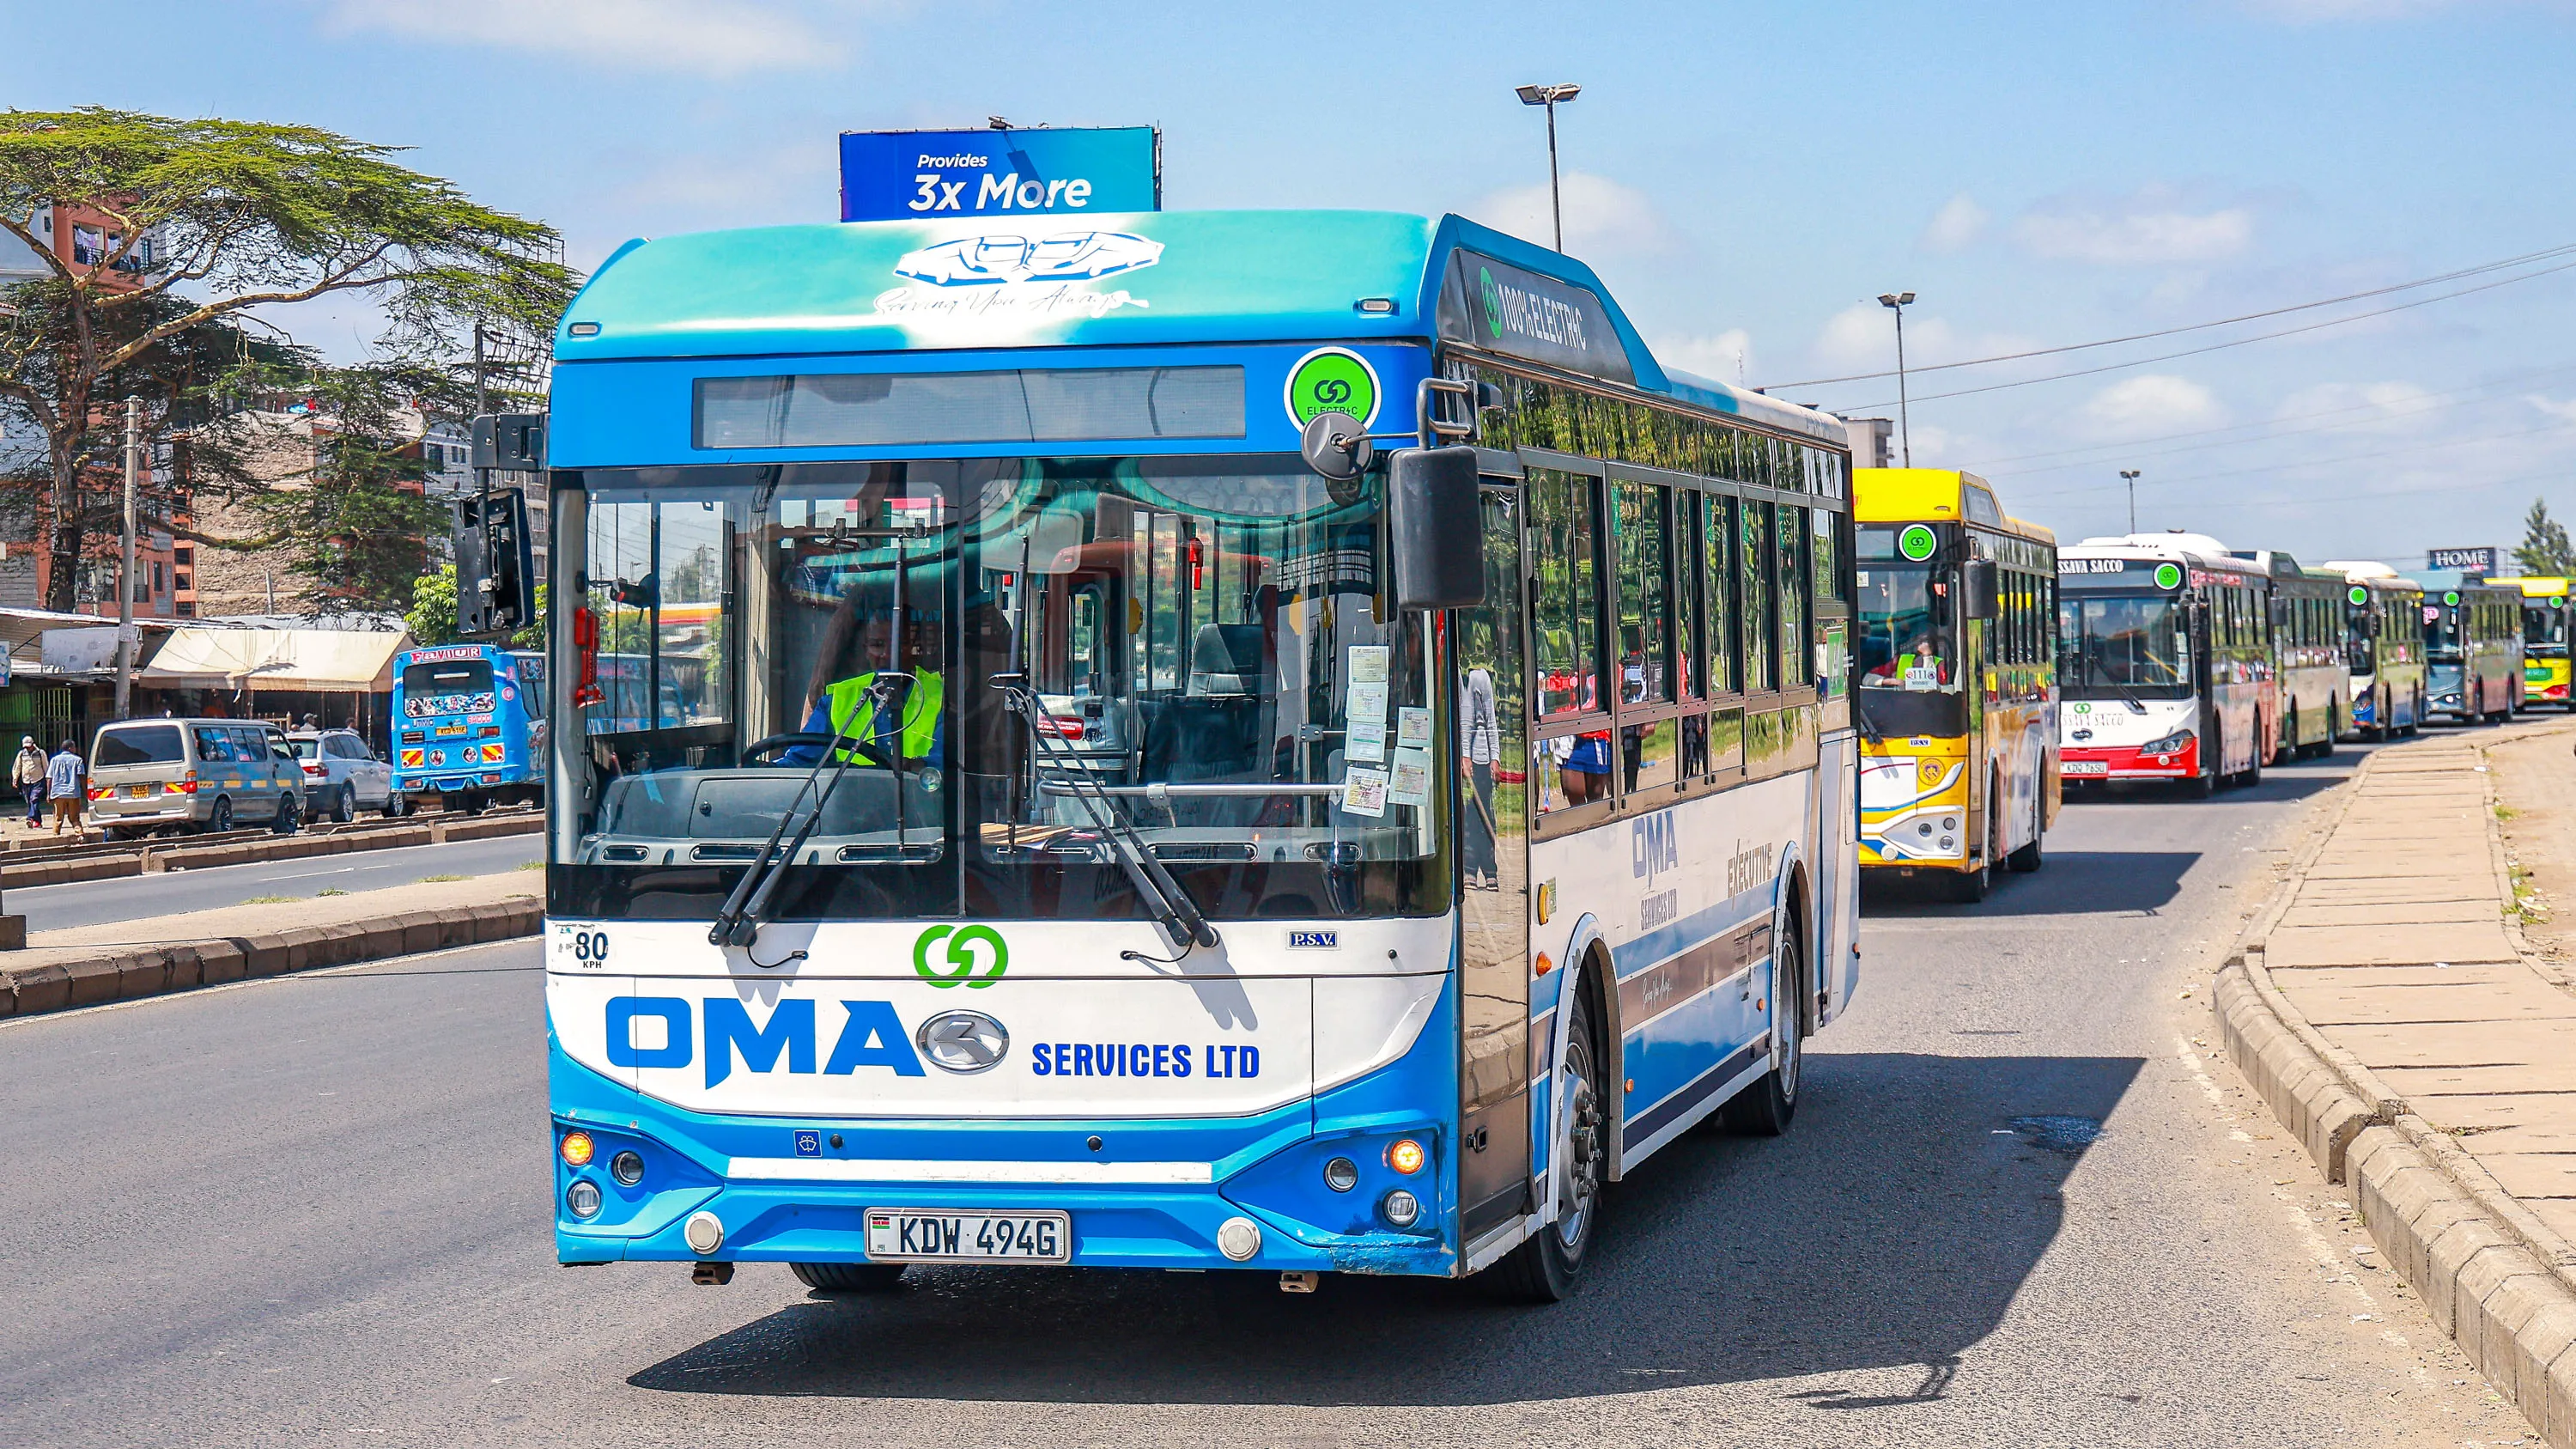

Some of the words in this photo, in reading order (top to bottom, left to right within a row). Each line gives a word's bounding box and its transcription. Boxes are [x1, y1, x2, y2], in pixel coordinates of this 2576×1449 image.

[917, 153, 988, 168] Provides
[908, 174, 968, 211] 3x
[975, 173, 1092, 210] More
[2089, 559, 2124, 573] SACCO
[2435, 550, 2489, 566] HOME
[467, 714, 492, 724] SACCO
[1632, 810, 1679, 891] OMA
[1727, 838, 1772, 911] EXECUTIVE
[1641, 892, 1668, 931] SERVICES
[575, 932, 609, 960] 80
[1293, 933, 1334, 946] P.S.V.
[582, 960, 602, 969] KPH
[605, 996, 927, 1090] OMA
[1032, 1043, 1192, 1078] SERVICES
[1206, 1044, 1260, 1079] LTD
[899, 1217, 961, 1254] KDW
[976, 1219, 1056, 1256] 494G
